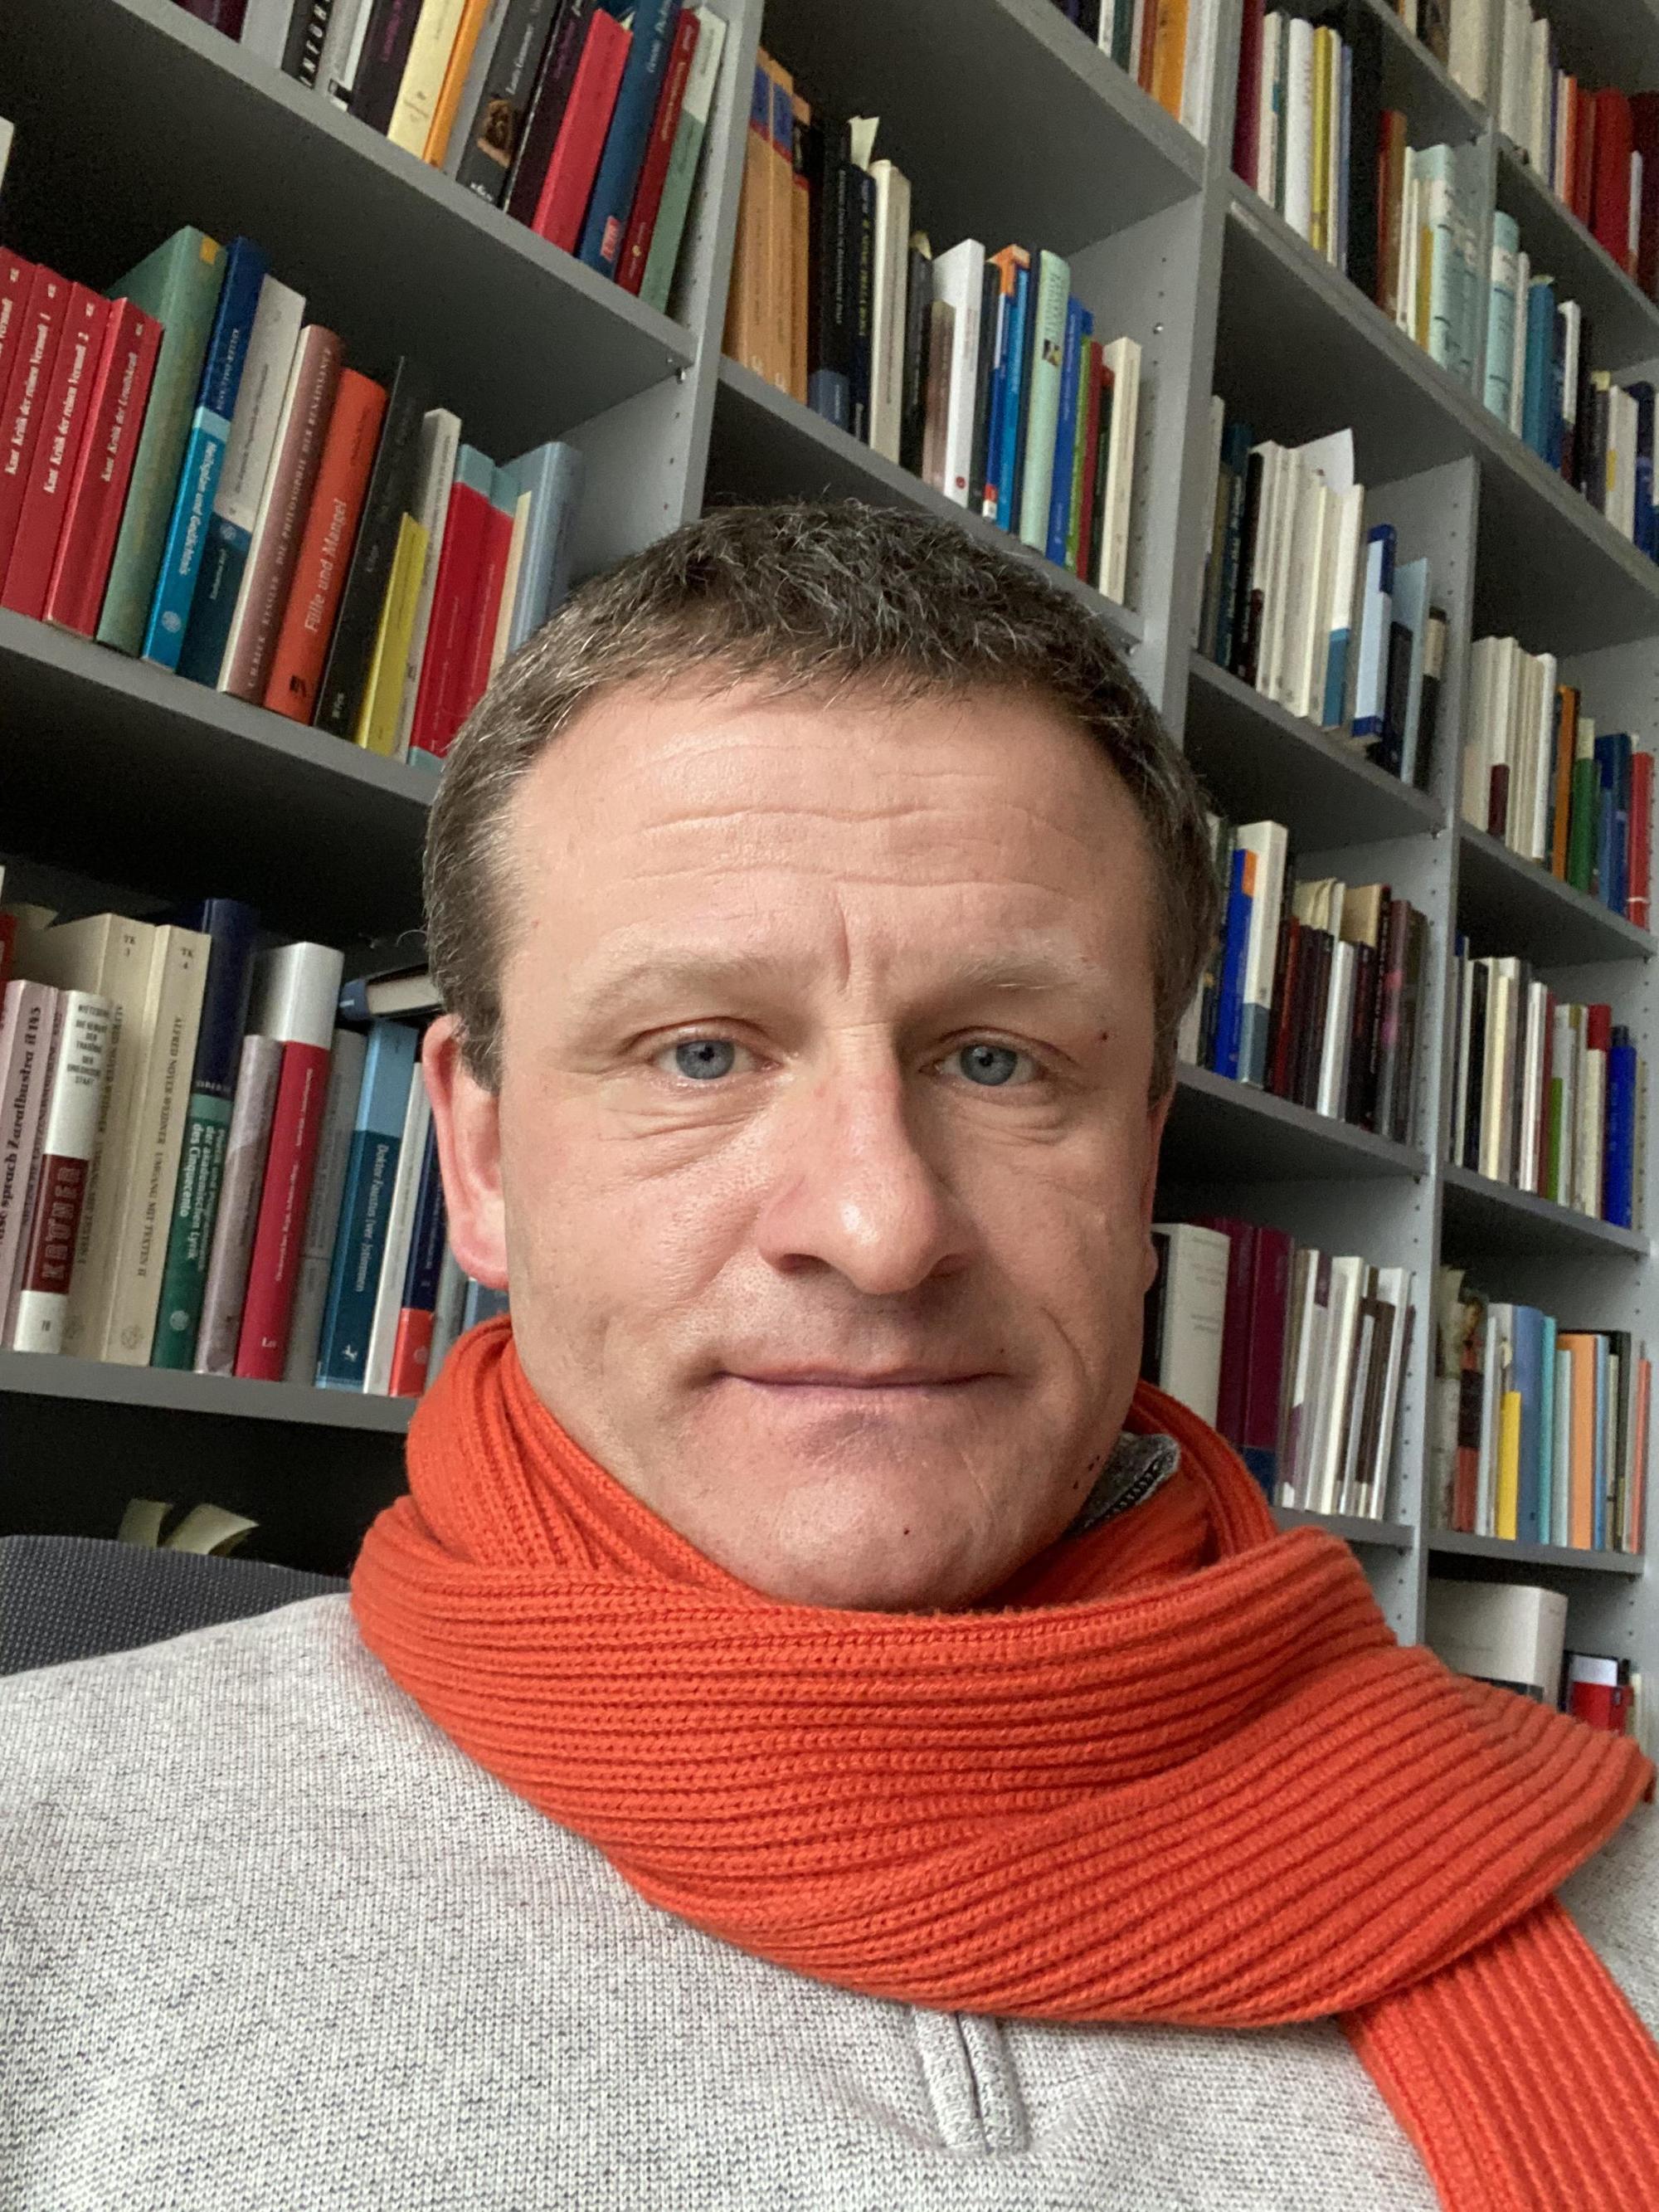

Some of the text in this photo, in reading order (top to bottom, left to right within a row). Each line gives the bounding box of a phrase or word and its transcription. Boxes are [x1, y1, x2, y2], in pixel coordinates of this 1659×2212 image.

[29, 324, 49, 363] Vernunft
[25, 366, 40, 397] reinen
[20, 398, 32, 415] der
[44, 332, 90, 493] Kant Kritik der reinen Vernunft 2
[12, 417, 28, 445] Kritik
[100, 457, 115, 482] Kant
[114, 407, 127, 425] der
[5, 450, 21, 474] Kant
[192, 491, 207, 515] und
[304, 498, 348, 632] Fülle und Mangel
[171, 1018, 183, 1055] ALFRED
[7, 1050, 34, 1149] Zarathustra
[2, 1152, 17, 1208] sprach
[149, 1152, 163, 1198] UMGANG
[179, 1123, 203, 1217] des Cinquecento
[374, 1144, 389, 1181] Doktor
[146, 1202, 156, 1221] MIT
[367, 1181, 382, 1217] Faustus
[42, 1167, 81, 1279] KRÖNER
[139, 1226, 153, 1265] TEXTEN
[187, 1231, 201, 1259] Lyrik
